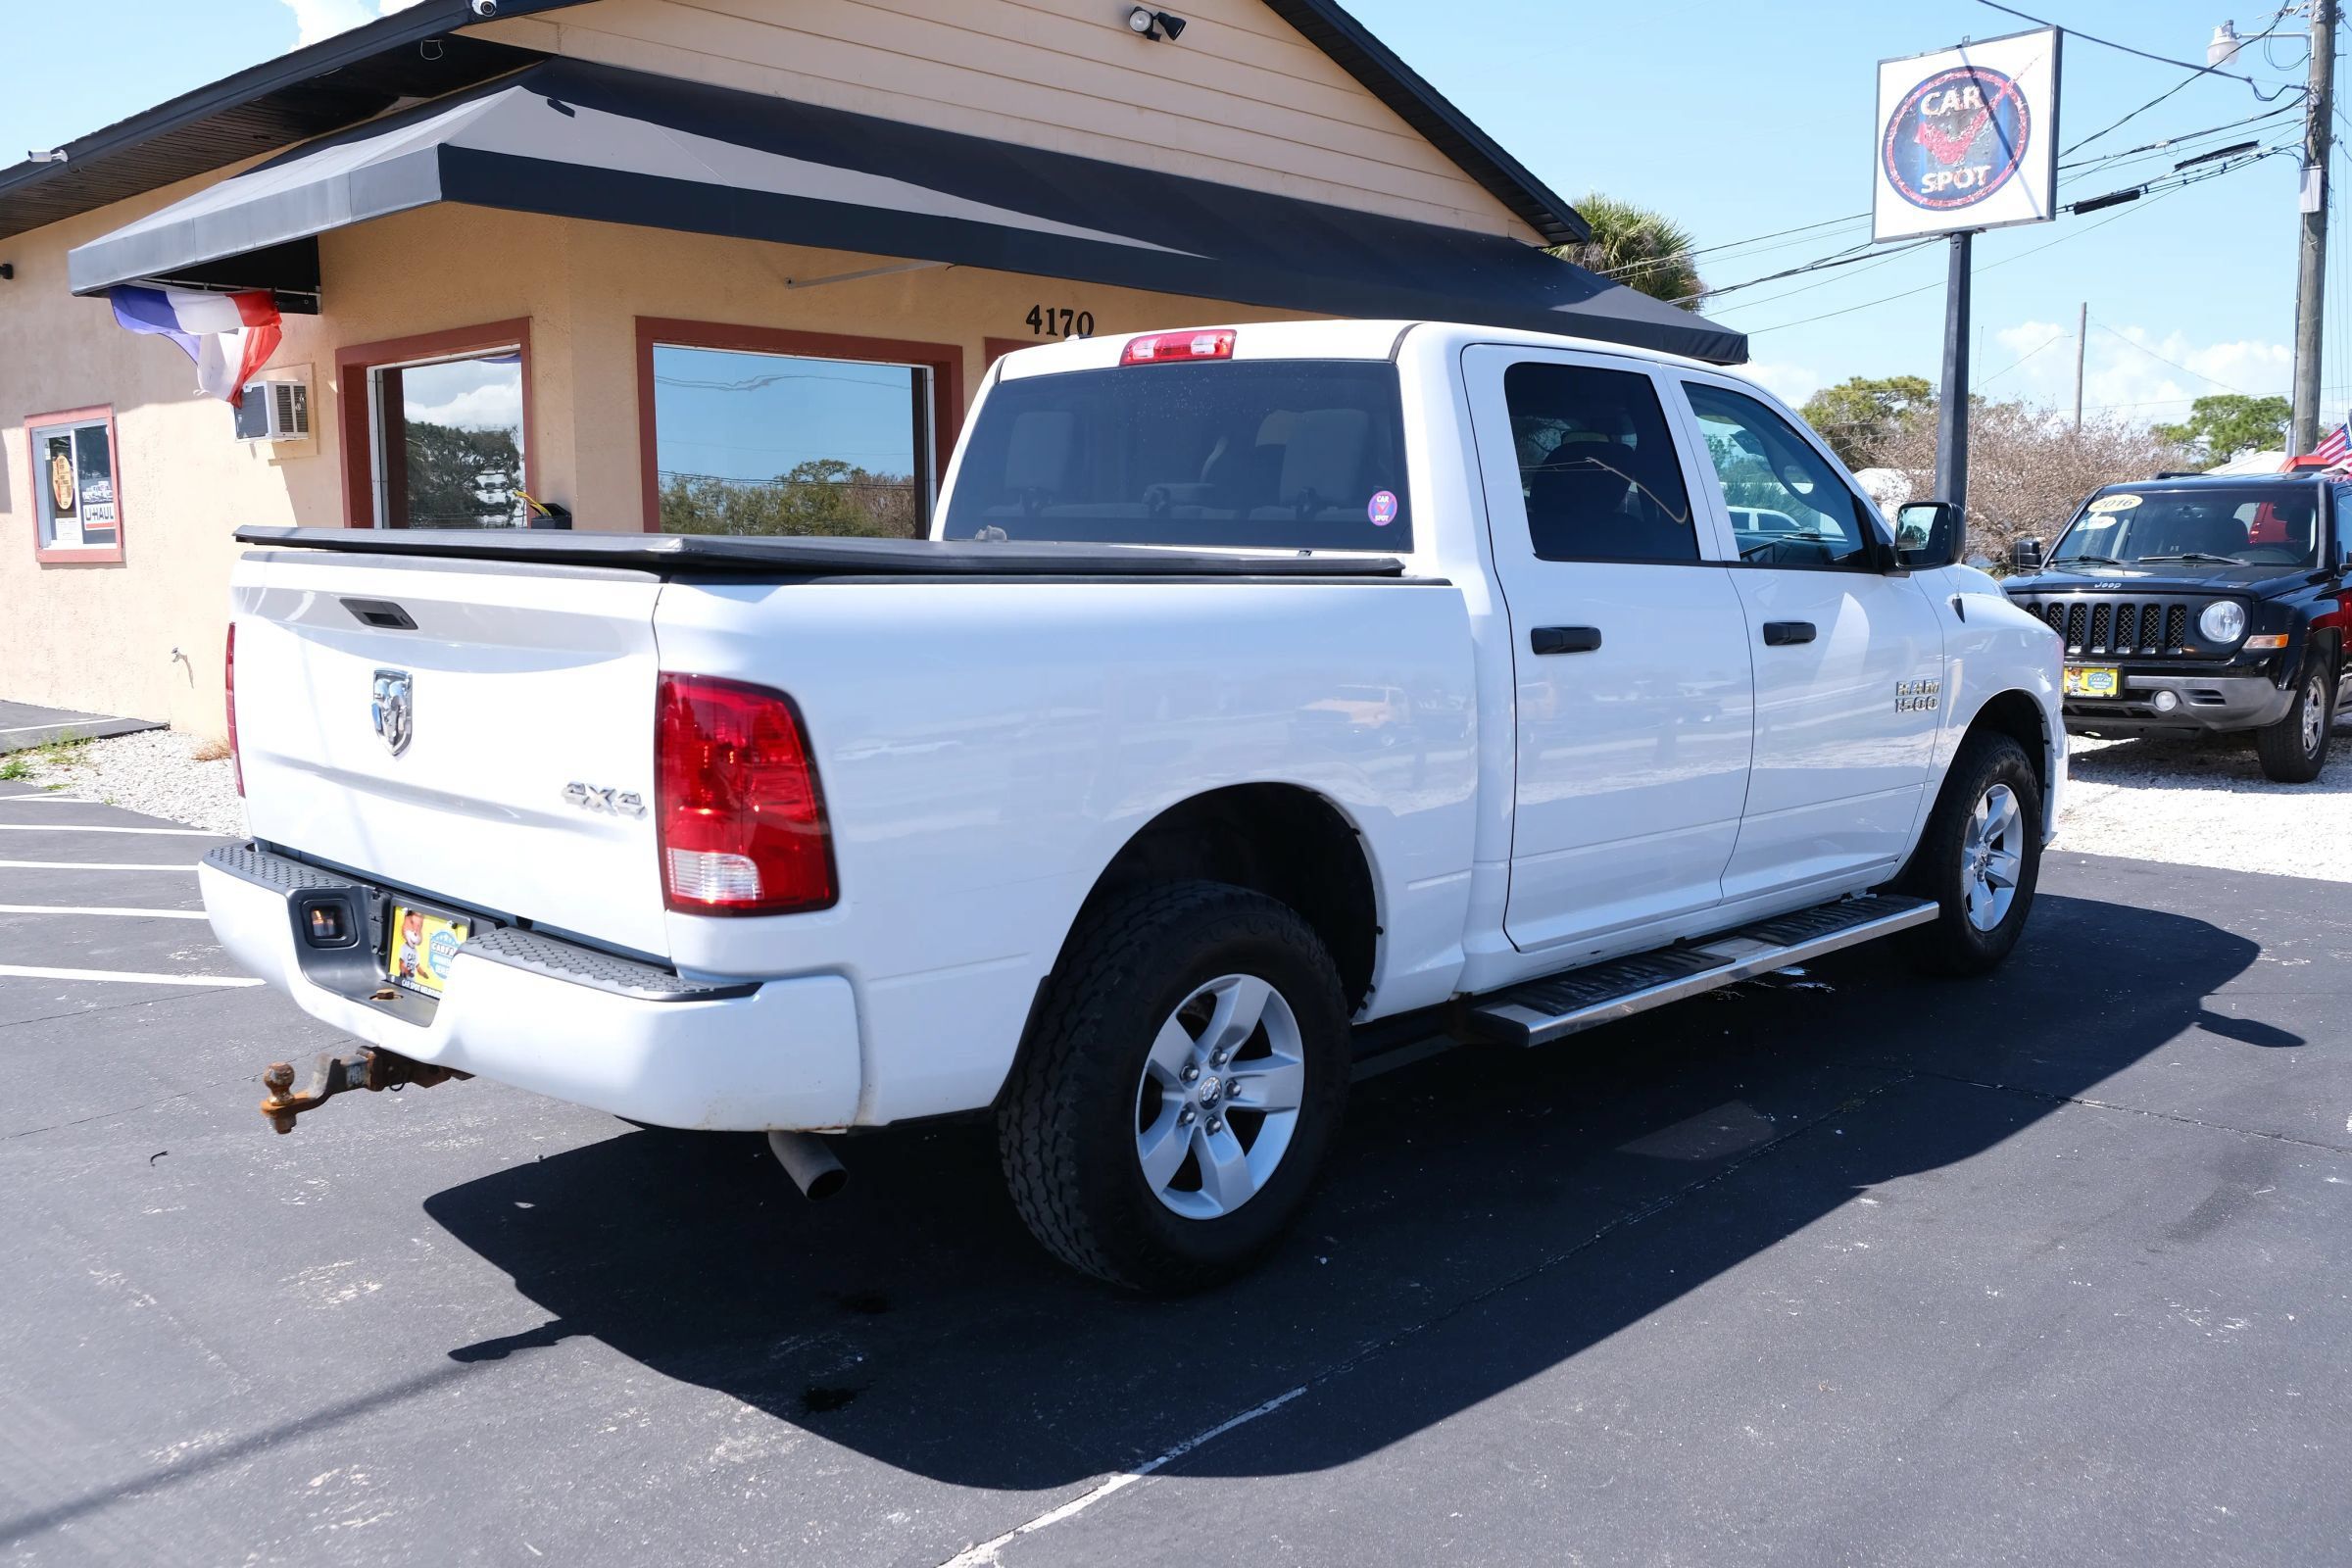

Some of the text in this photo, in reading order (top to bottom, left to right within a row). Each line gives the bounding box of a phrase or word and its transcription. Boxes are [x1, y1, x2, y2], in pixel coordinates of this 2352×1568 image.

[1920, 85, 1985, 117] CAR
[1921, 165, 1992, 194] SPOT
[1025, 304, 1095, 338] 4170
[2094, 498, 2137, 510] 2016
[85, 506, 114, 521] U-HAUL
[1895, 678, 1939, 696] RAM
[1894, 696, 1938, 713] 1500
[431, 942, 456, 956] CARFA
